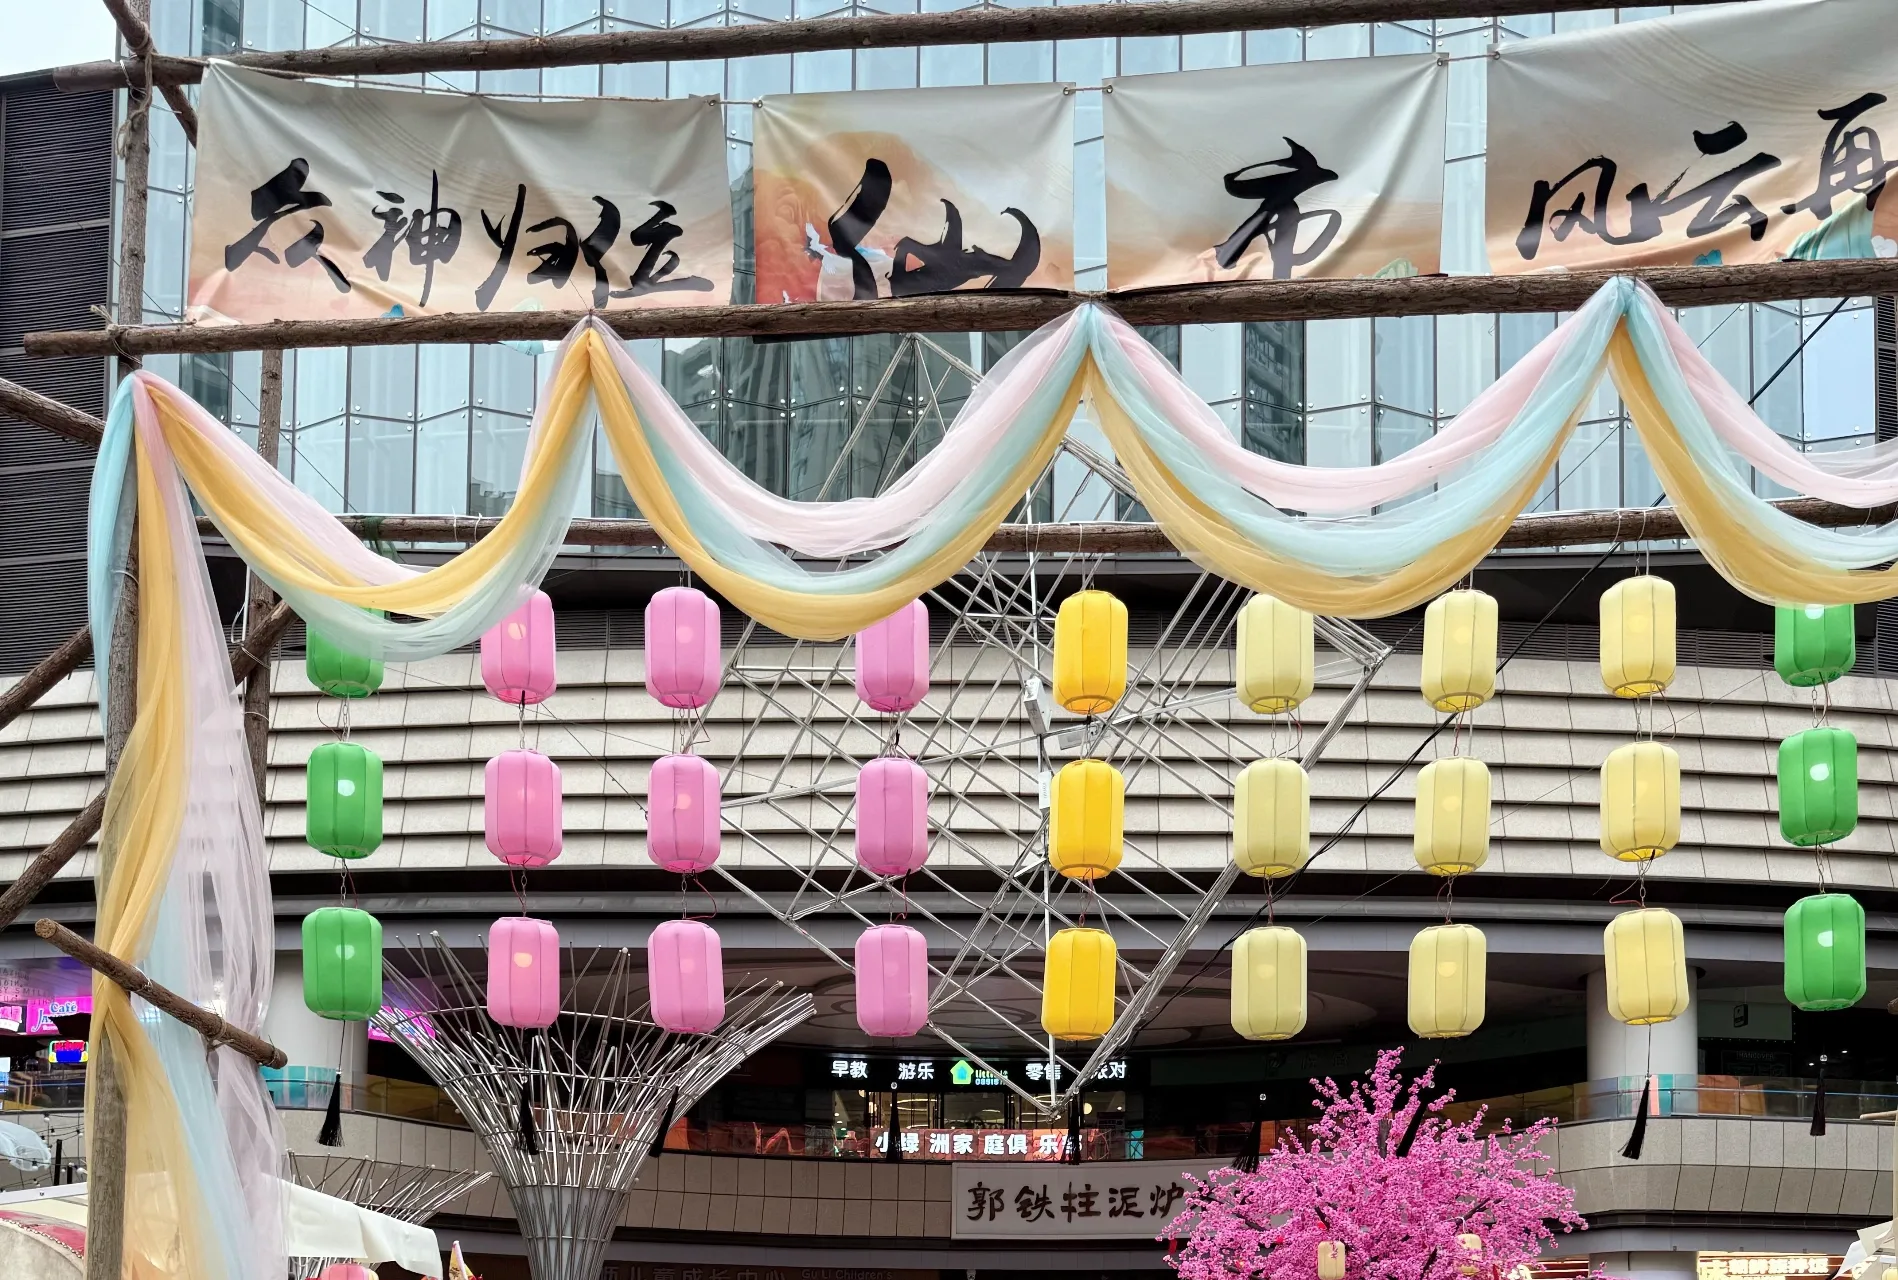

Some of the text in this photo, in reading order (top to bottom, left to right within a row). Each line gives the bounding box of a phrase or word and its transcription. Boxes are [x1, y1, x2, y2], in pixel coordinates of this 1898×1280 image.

[225, 157, 714, 311] 众神归位
[1213, 136, 1342, 280] 市
[831, 1060, 935, 1080] 早教 游乐
[1025, 1063, 1062, 1081] 零售
